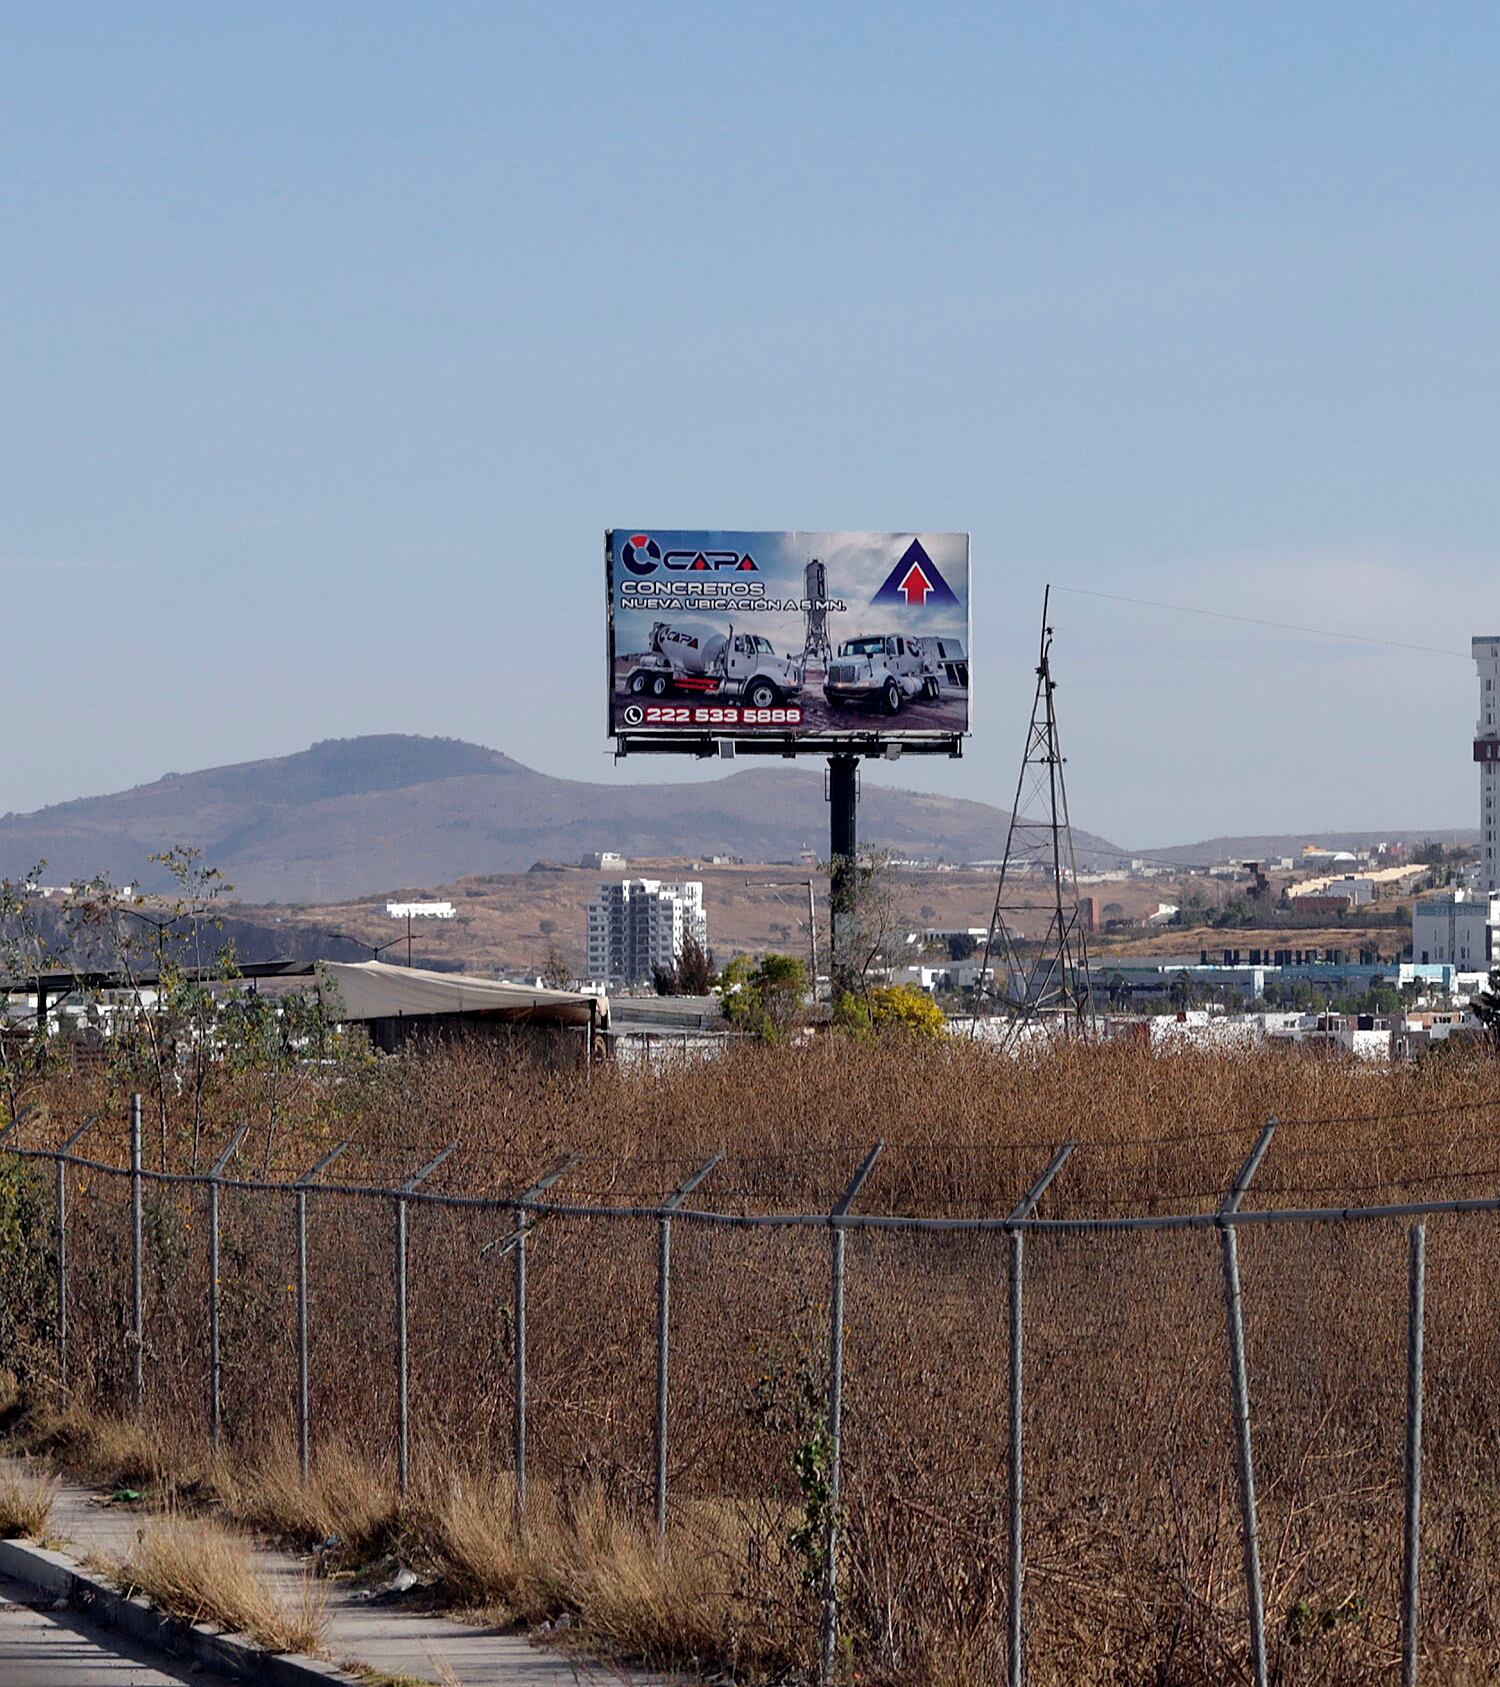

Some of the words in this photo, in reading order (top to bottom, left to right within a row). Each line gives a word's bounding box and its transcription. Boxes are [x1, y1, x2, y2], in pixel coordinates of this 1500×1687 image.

[663, 550, 760, 572] CAPA
[620, 581, 765, 597] CONCRETOS
[621, 598, 684, 610] NUEVA
[686, 597, 781, 611] UBICACIÓN
[783, 599, 798, 611] A
[800, 599, 812, 611] 5
[668, 631, 699, 650] CAPA
[646, 708, 690, 722] 222
[695, 708, 738, 723] 533
[743, 709, 800, 723] 5888
